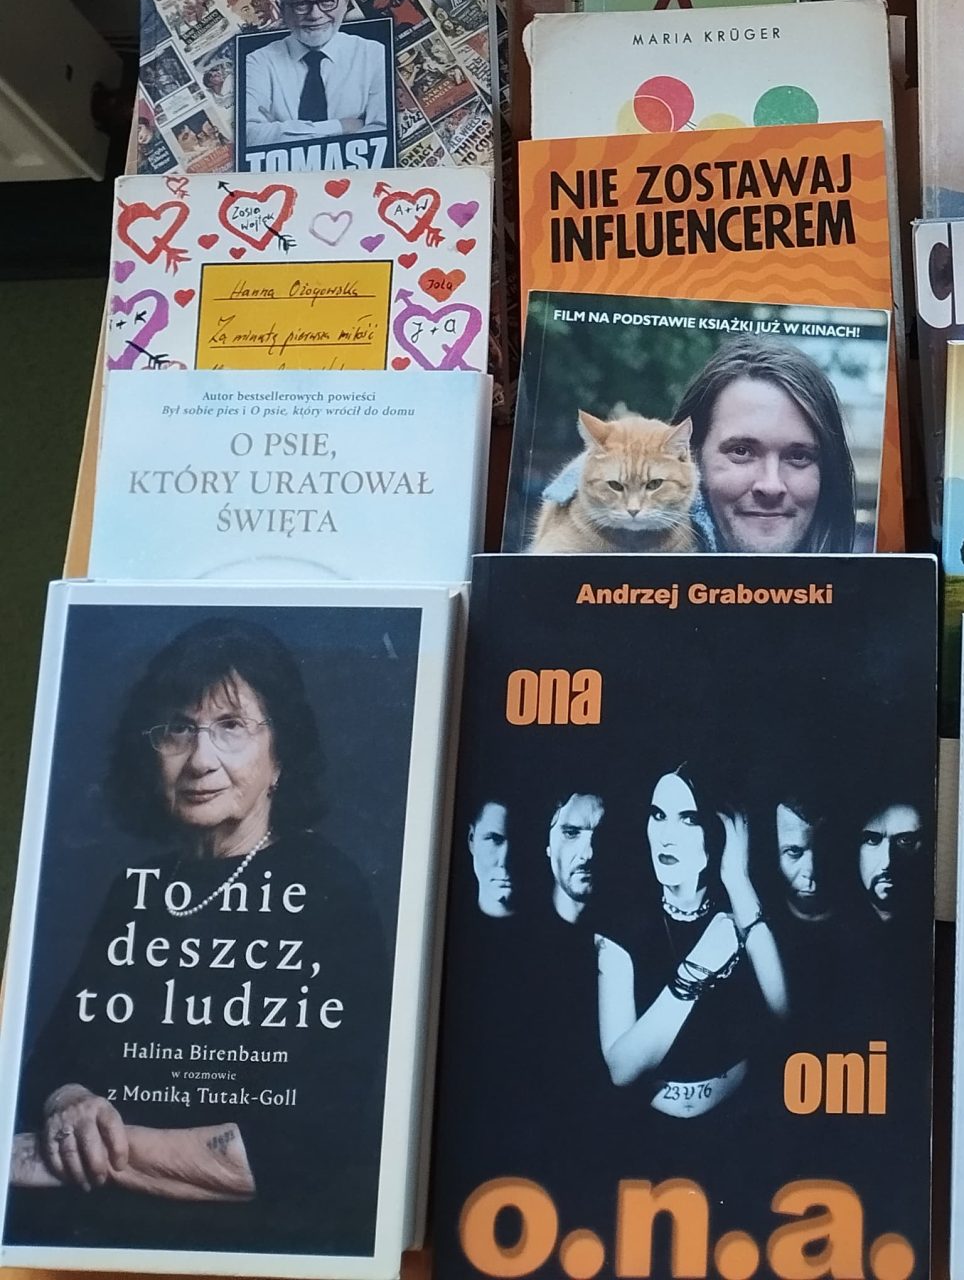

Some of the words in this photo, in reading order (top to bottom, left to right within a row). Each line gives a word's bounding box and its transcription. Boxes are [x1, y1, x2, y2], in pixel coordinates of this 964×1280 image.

[633, 32, 692, 45] MARIA
[705, 27, 781, 42] KRÜGER
[245, 137, 388, 172] TOMASZ
[550, 169, 618, 210] NIE
[636, 154, 852, 205] ZOSTAWAJ
[551, 199, 855, 263] INFLUENCEREM
[553, 309, 585, 322] FILM
[588, 311, 609, 324] NA
[613, 313, 696, 329] PODSTAWIE
[699, 318, 753, 332] KSIĄŻKI
[755, 319, 780, 333] JUŻ
[784, 323, 800, 334] W
[802, 324, 860, 338] KINACH!
[202, 391, 233, 401] Autor
[237, 391, 324, 403] bestsellerowych
[328, 391, 376, 403] powieści
[231, 432, 253, 457] O
[264, 432, 337, 460] PSIE,
[129, 464, 239, 494] KTÓRY
[250, 470, 434, 495] URATOWAŁ
[216, 503, 338, 538] ŚWIĘTA
[576, 583, 679, 610] Andrzej
[688, 583, 833, 605] Grabowski
[506, 668, 603, 726] ona
[127, 868, 192, 912] To
[220, 871, 307, 914] nie
[107, 922, 321, 977] deszcz,
[75, 989, 134, 1023] to
[162, 979, 344, 1029] ludzie
[123, 1043, 183, 1060] Halina
[189, 1045, 288, 1063] Birenbaum
[783, 1040, 888, 1114] oni
[108, 1090, 116, 1100] z
[123, 1086, 190, 1107] Moniką
[197, 1087, 297, 1106] Tutak-Goll
[458, 1177, 915, 1280] o.n.a.
